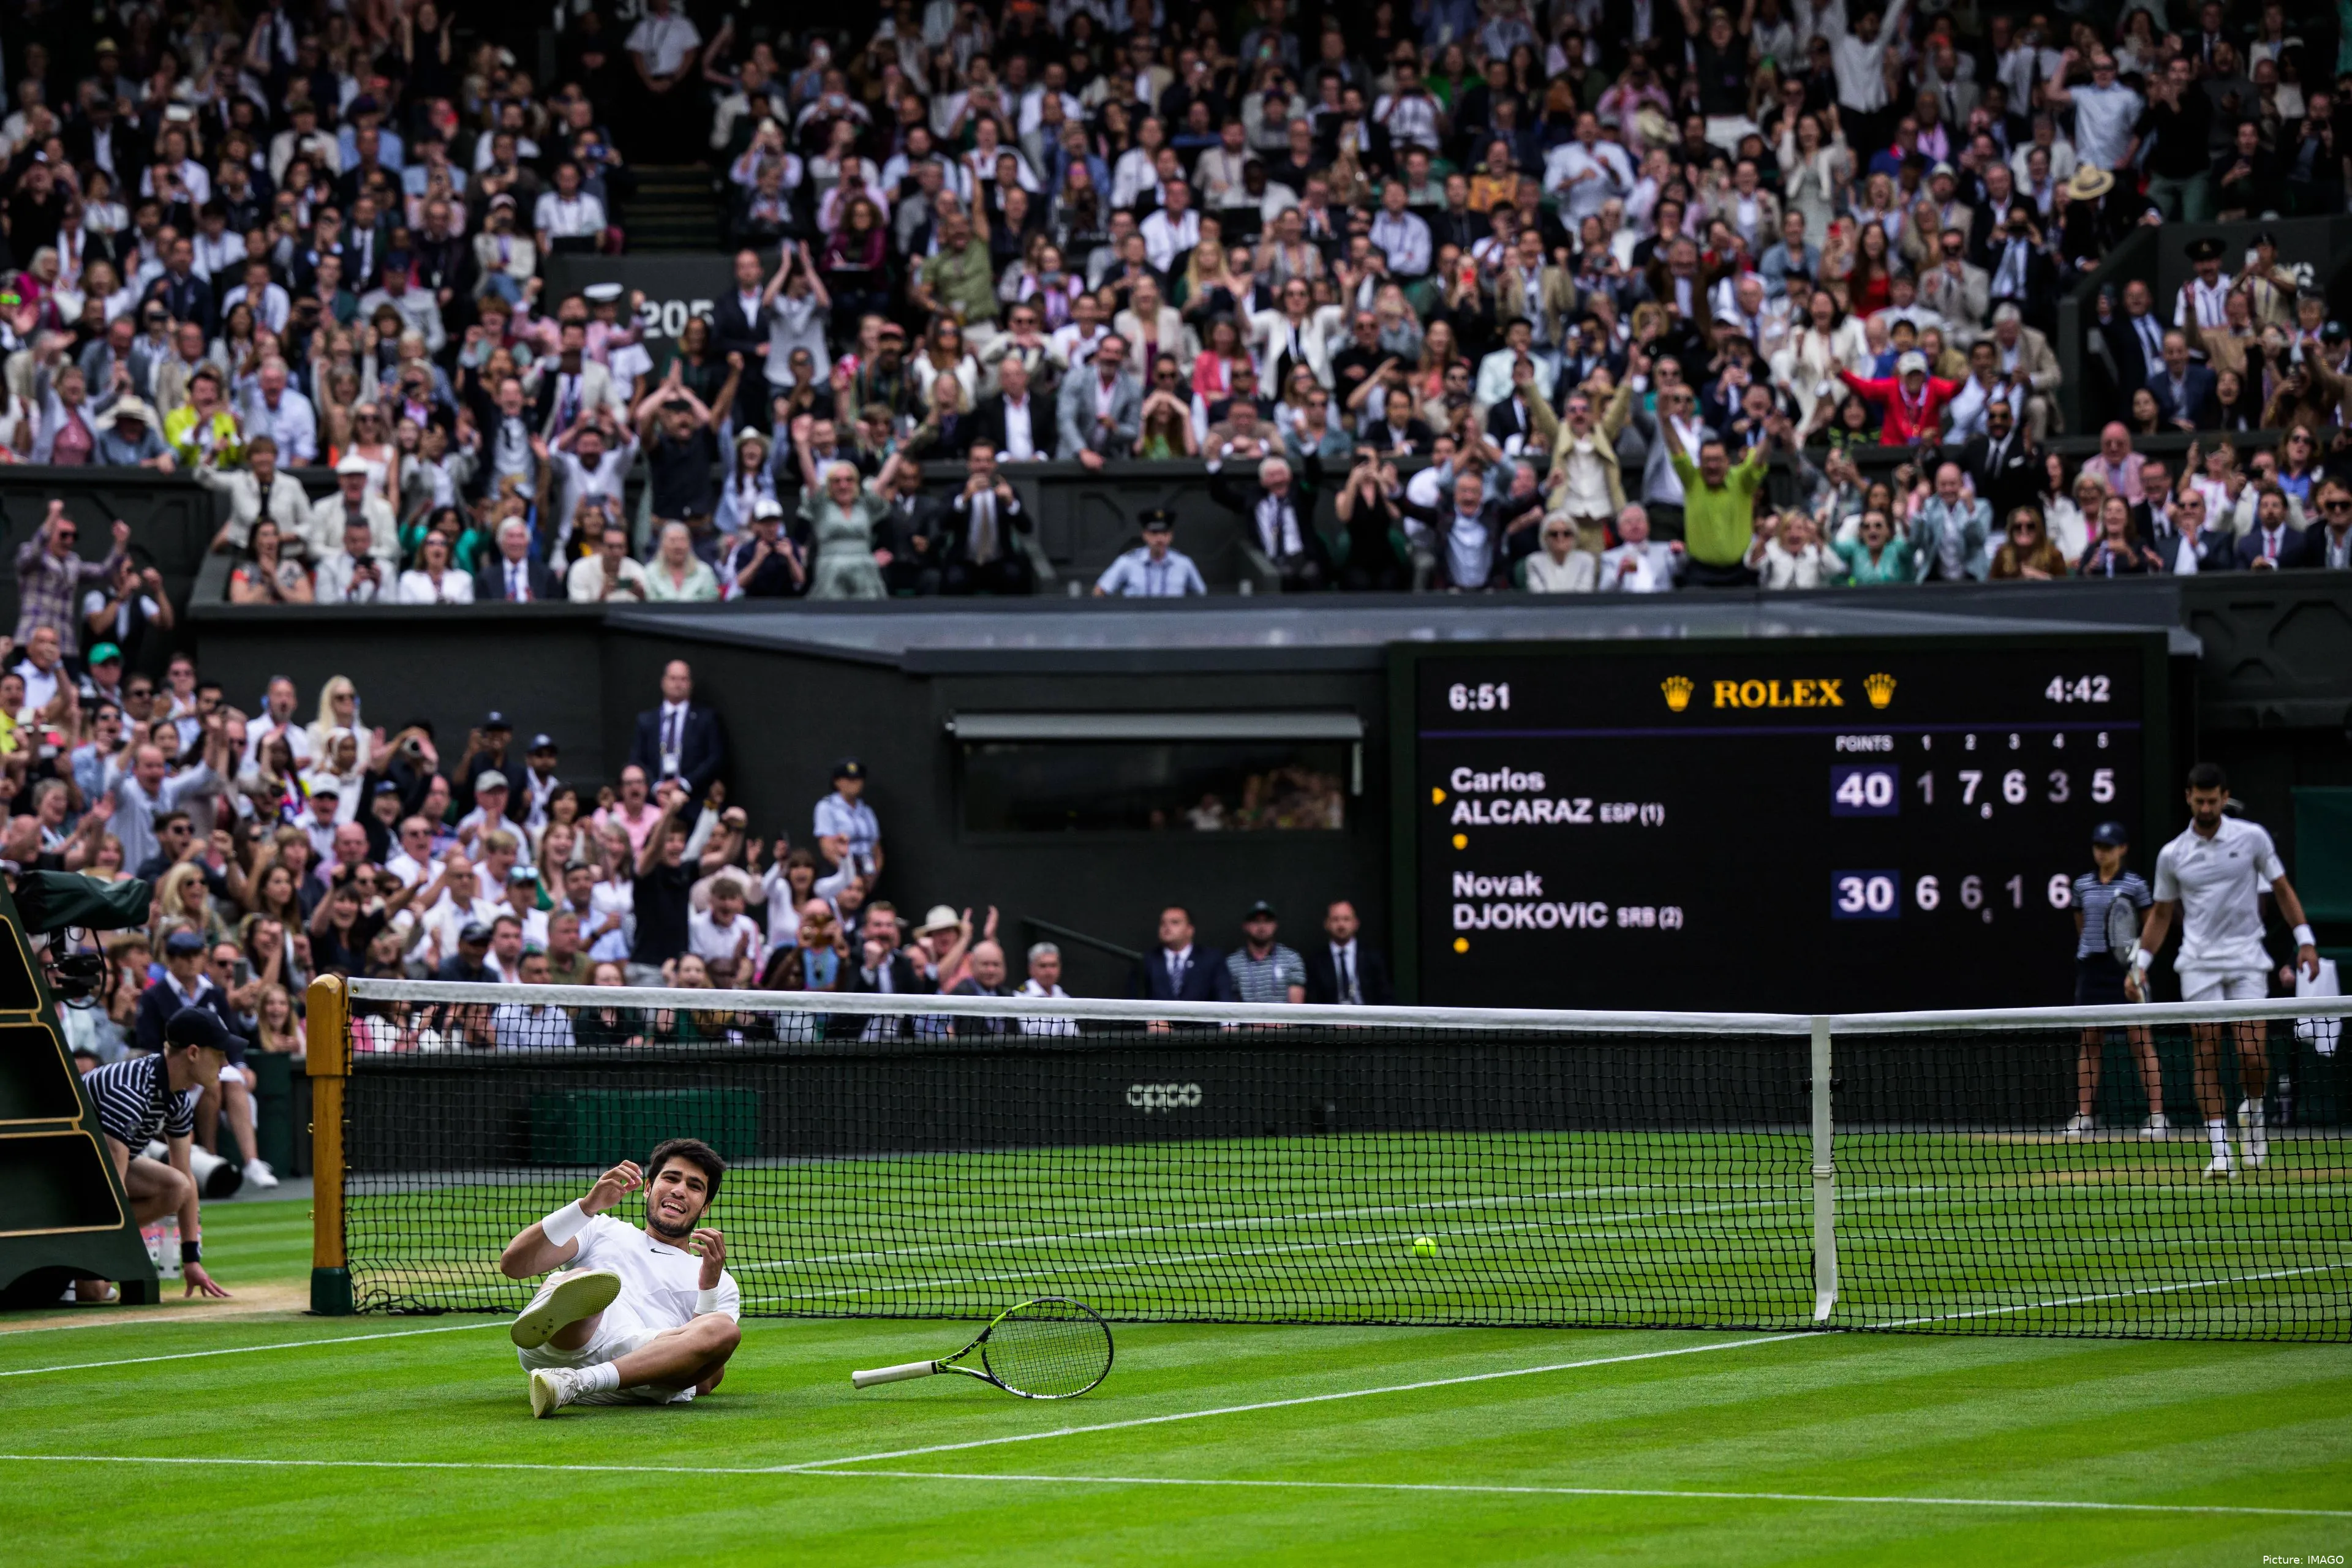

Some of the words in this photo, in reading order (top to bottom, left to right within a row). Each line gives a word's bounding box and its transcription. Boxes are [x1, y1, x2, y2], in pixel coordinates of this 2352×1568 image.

[1449, 682, 1510, 711] 6:51
[1714, 679, 1844, 708] ROLEX
[2045, 675, 2110, 703] 4:42
[1835, 734, 1894, 752] POINTS
[1921, 734, 1931, 751] 1
[1965, 733, 1977, 750] 2
[2008, 733, 2020, 750] 3
[2052, 733, 2064, 748] 4
[1450, 766, 1546, 793] Carlos
[1836, 772, 1893, 807] 40
[1917, 772, 1933, 804] 1
[1958, 770, 1983, 805] 7
[2002, 769, 2027, 805] 6
[2048, 770, 2070, 802] 3
[2091, 768, 2116, 803] 5
[1450, 797, 1594, 825] ALCARAZ
[1599, 802, 1639, 823] ESP
[1639, 803, 1665, 827] (1)
[1452, 870, 1544, 898] Novak
[1839, 876, 1894, 912] 30
[1915, 875, 1940, 911] 6
[1961, 875, 1983, 910] 6
[2006, 875, 2022, 908] 1
[2048, 873, 2073, 909] 6
[1453, 901, 1608, 930] DJOKOVIC
[1616, 906, 1656, 928] SRB
[1658, 906, 1684, 930] (2)
[1126, 1083, 1202, 1113] oppo
